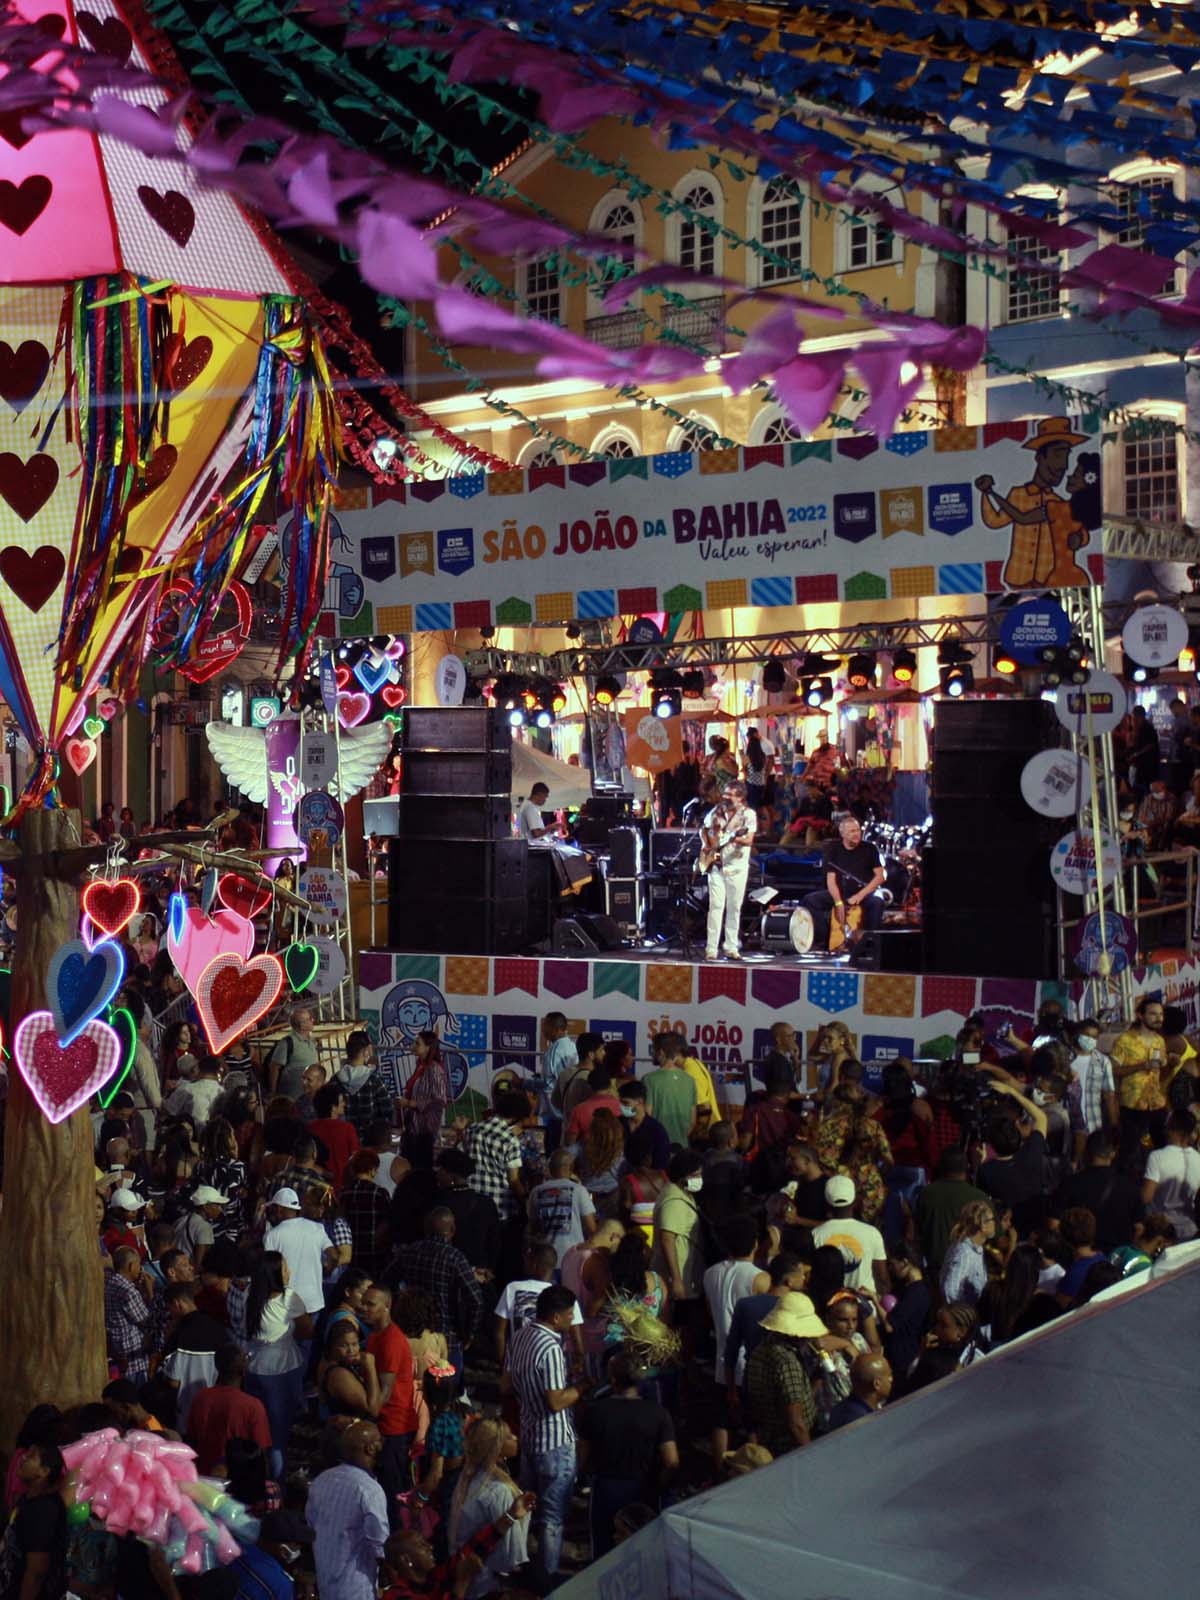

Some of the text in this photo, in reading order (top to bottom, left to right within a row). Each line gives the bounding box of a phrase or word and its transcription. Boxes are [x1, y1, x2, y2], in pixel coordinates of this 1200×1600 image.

[483, 499, 827, 564] SÃO JOÃO DA BAHIA 2022
[698, 530, 829, 562] Valeu esperar!
[690, 1020, 743, 1046] JOÃO
